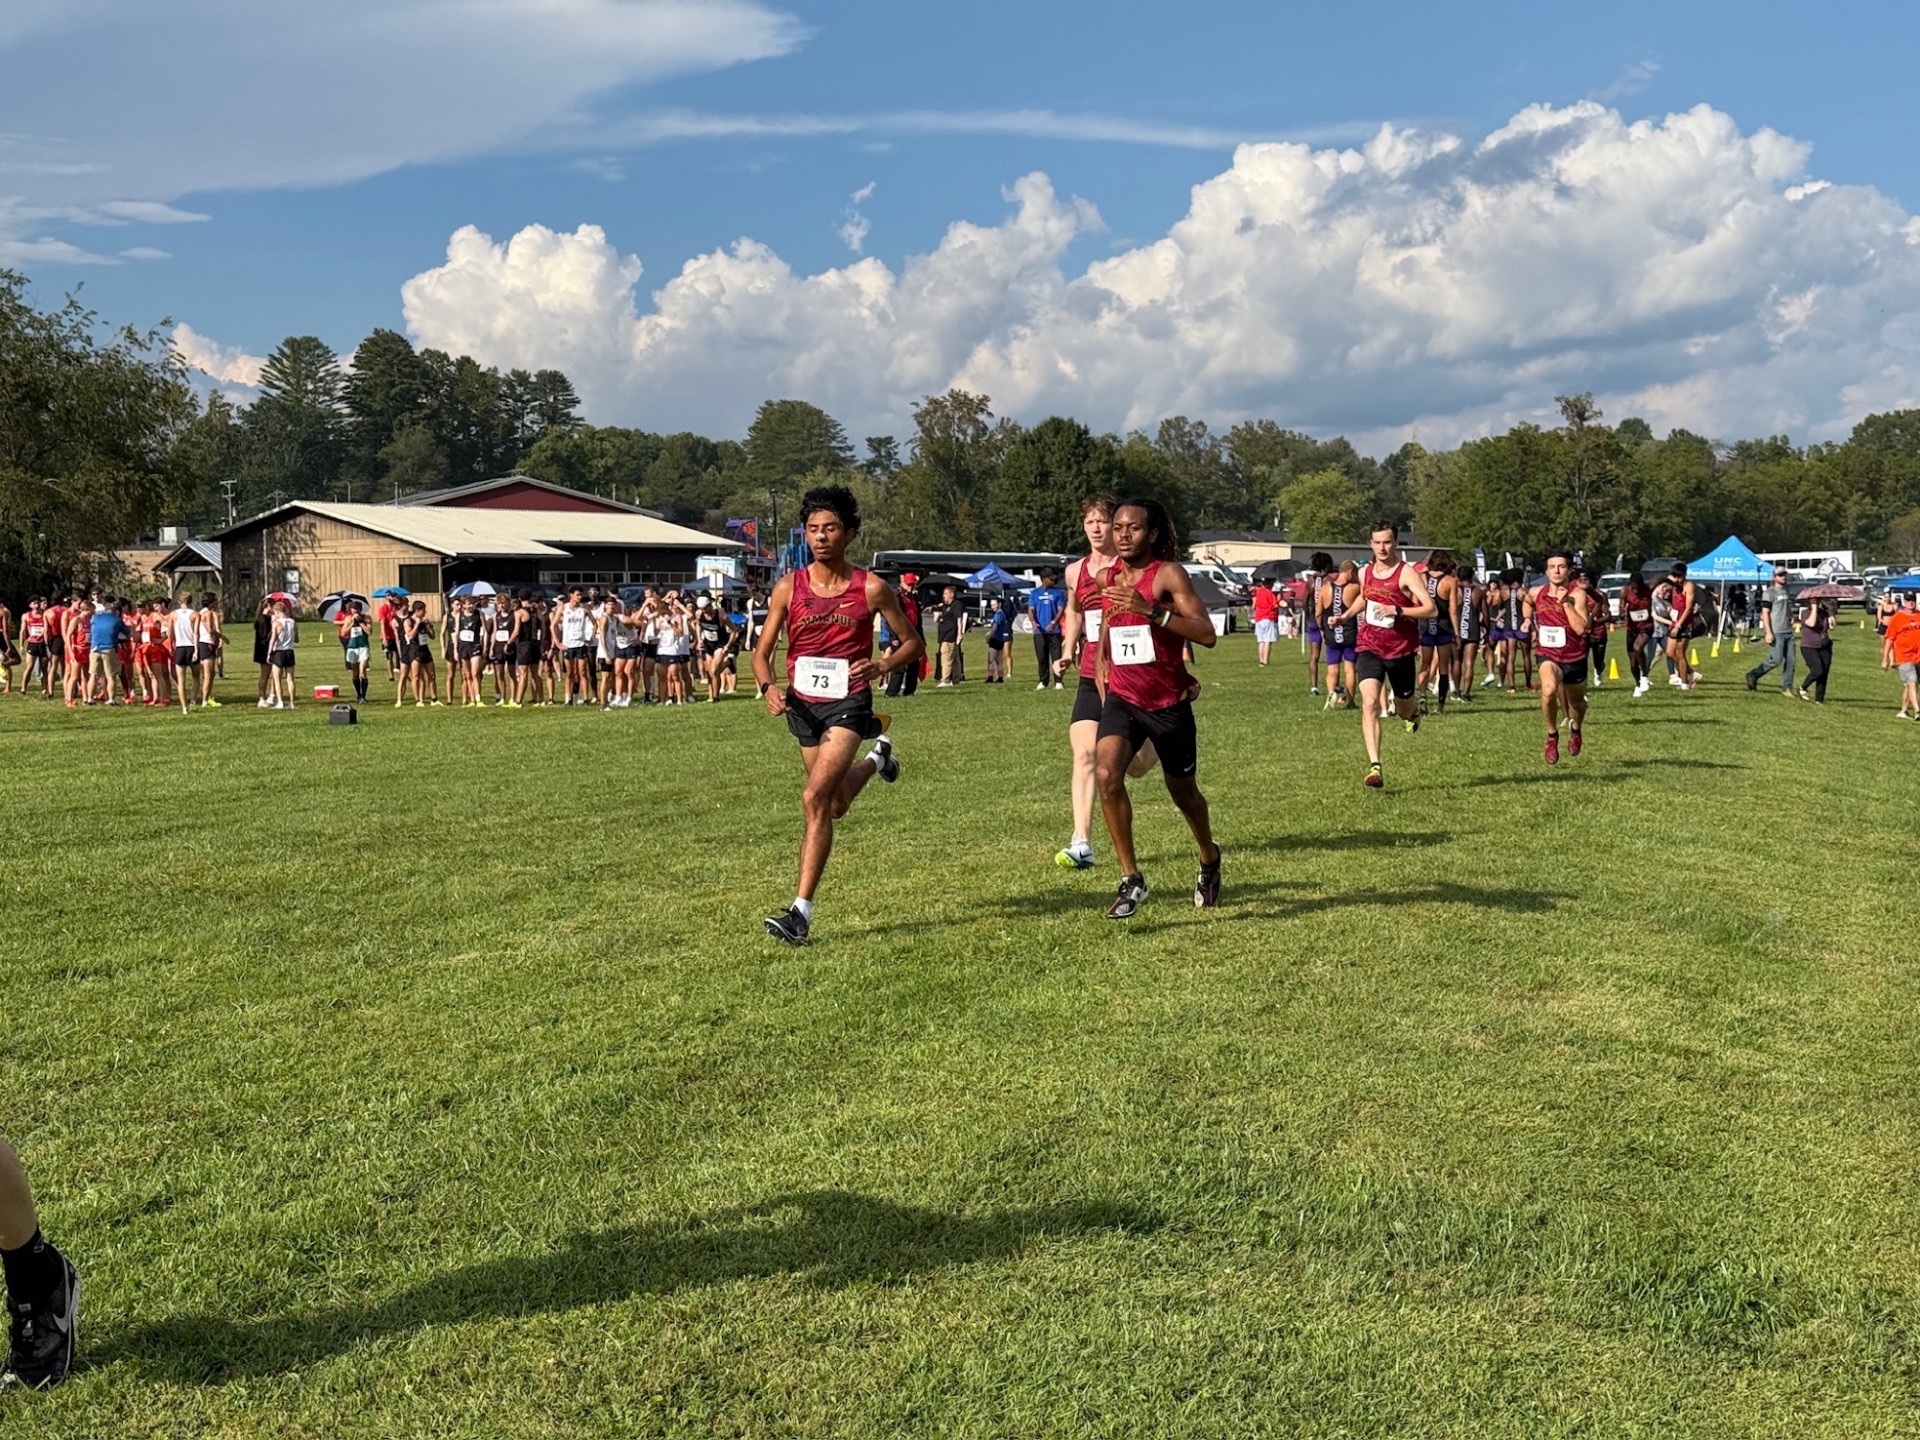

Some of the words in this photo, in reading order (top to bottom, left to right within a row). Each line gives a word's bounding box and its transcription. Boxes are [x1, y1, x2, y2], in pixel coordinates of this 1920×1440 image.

[1714, 556, 1743, 564] UNC
[1712, 568, 1736, 578] Sports
[1737, 568, 1769, 577] Medicne
[1547, 635, 1556, 643] 78
[1122, 643, 1136, 656] 71
[812, 675, 829, 688] 73
